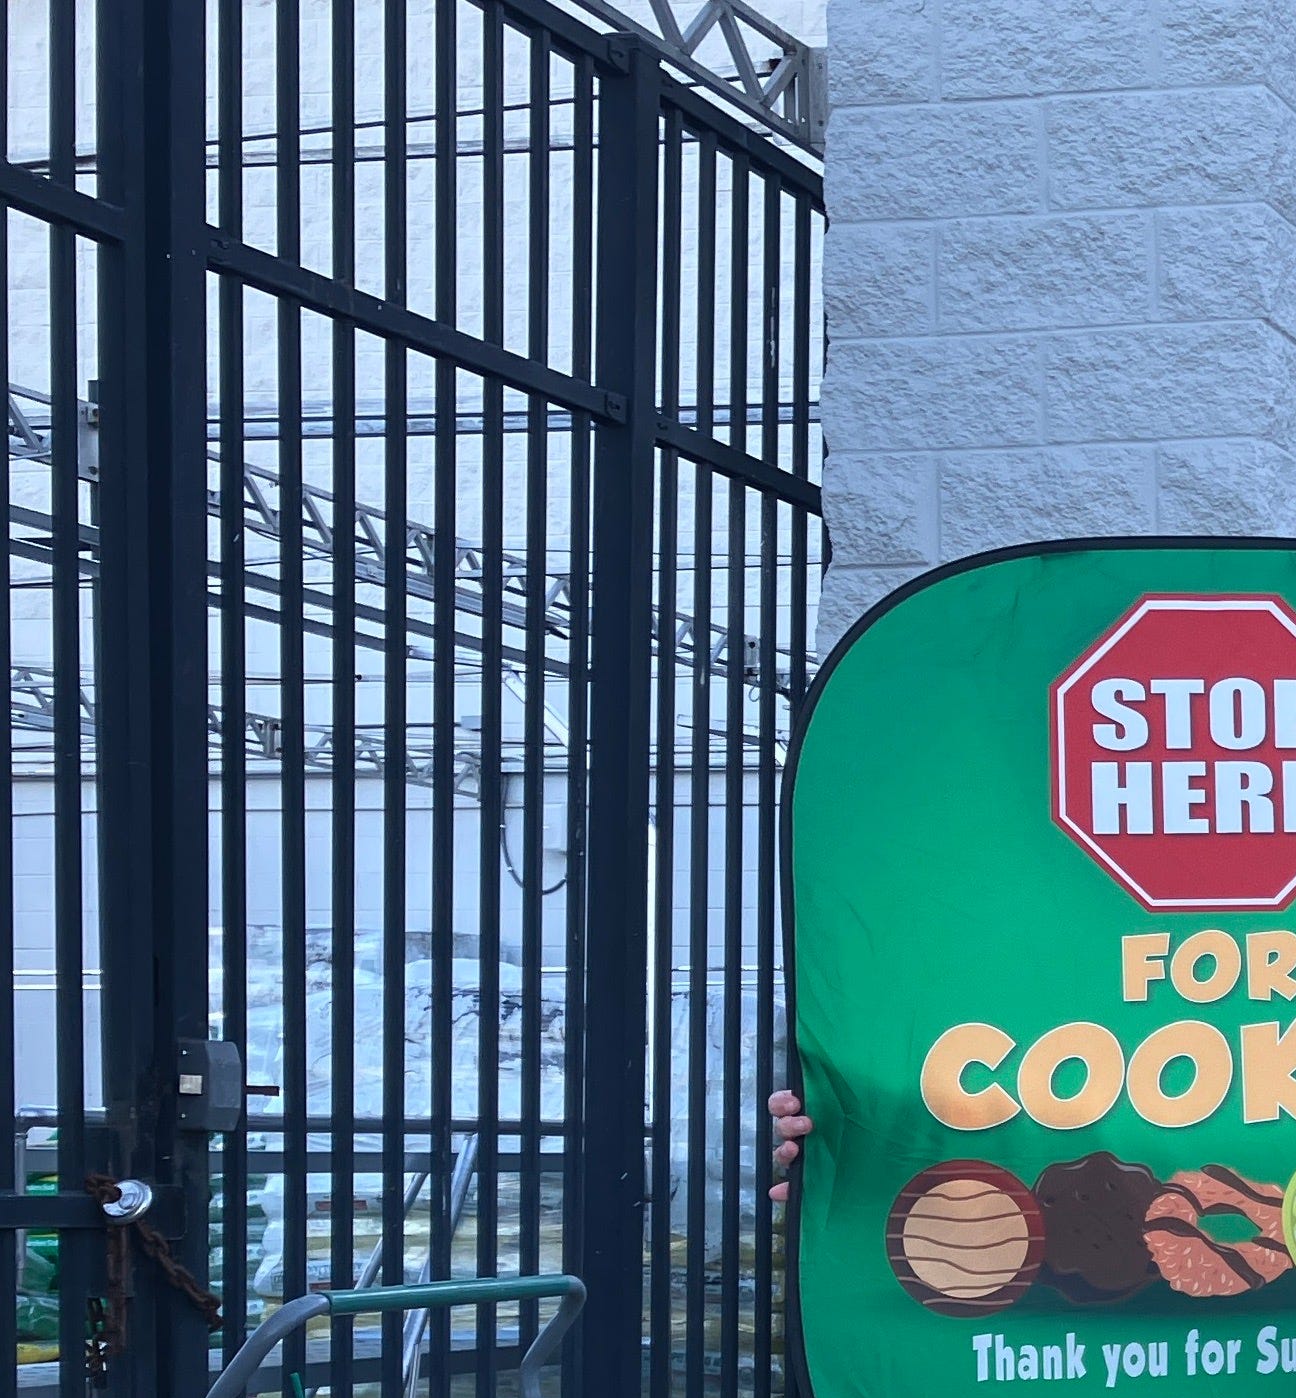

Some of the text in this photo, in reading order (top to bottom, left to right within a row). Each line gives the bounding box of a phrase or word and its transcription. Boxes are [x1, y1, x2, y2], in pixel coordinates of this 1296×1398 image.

[972, 1332, 1087, 1382] Thank
[1102, 1340, 1170, 1388] you
[1185, 1329, 1242, 1376] for
